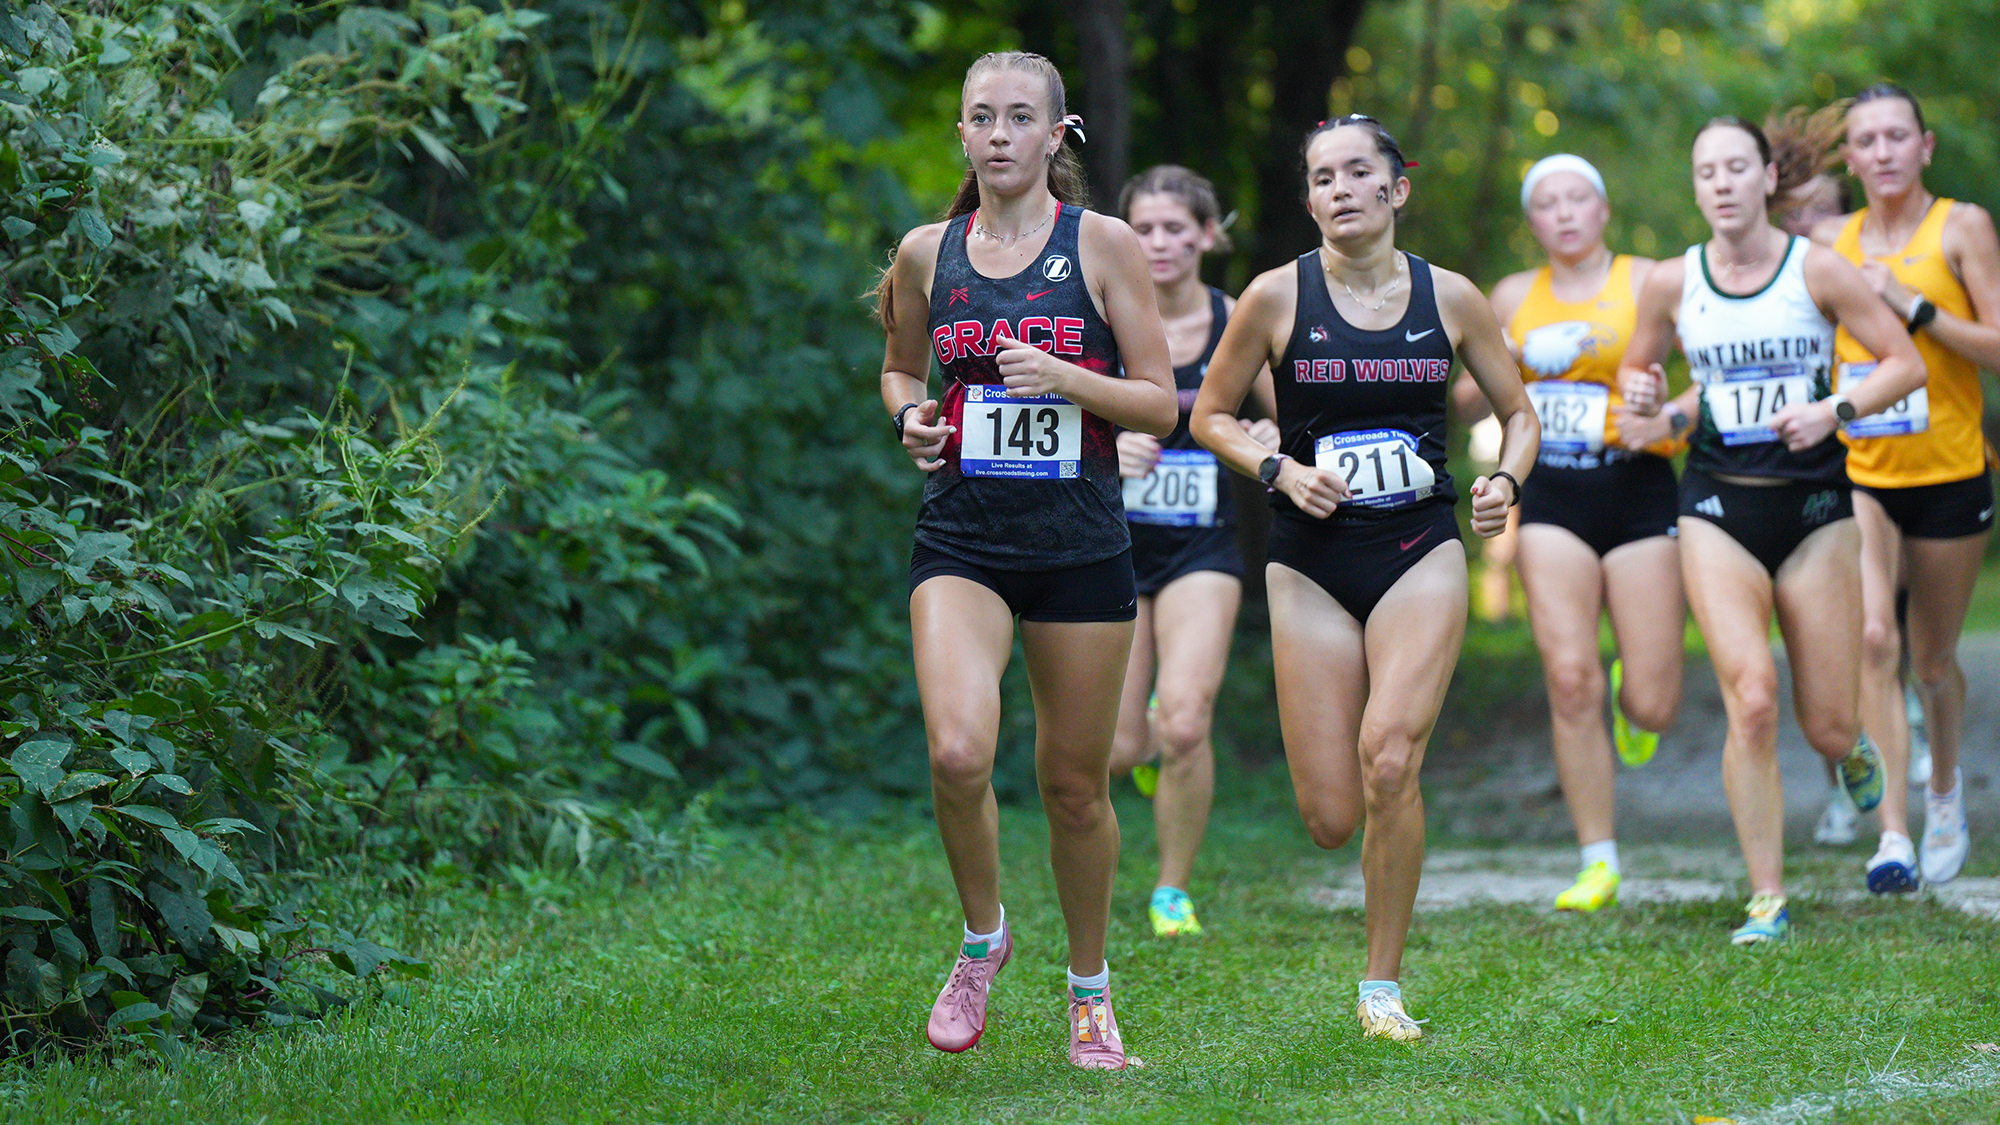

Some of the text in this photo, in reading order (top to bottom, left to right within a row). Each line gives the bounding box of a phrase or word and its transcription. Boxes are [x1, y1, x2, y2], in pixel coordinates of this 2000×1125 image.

[933, 316, 1084, 365] GRACE
[1294, 359, 1449, 383] RED WOLVES
[1730, 384, 1786, 424] 174
[986, 407, 1060, 457] 143
[1334, 430, 1389, 445] Crossroads
[1142, 469, 1200, 507] 206
[1338, 443, 1411, 495] 211
